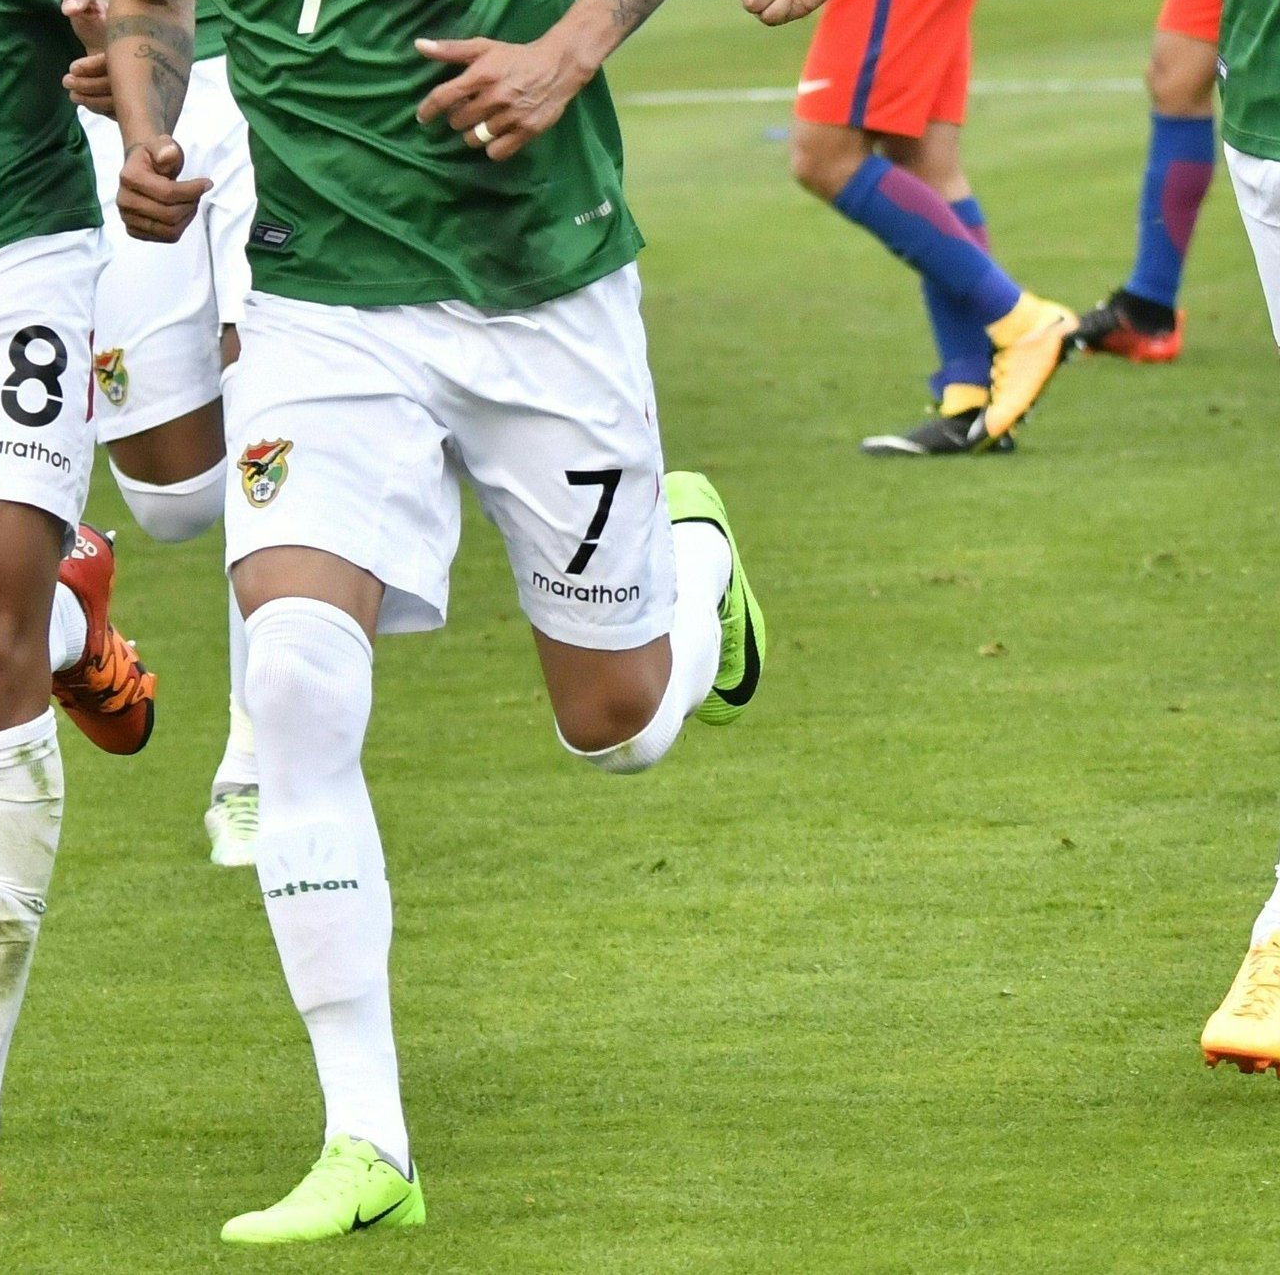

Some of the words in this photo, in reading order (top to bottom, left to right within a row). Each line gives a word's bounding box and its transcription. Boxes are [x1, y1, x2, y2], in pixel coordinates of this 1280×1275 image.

[1, 324, 68, 427] 8
[564, 469, 623, 575] 7
[533, 571, 639, 604] marathon
